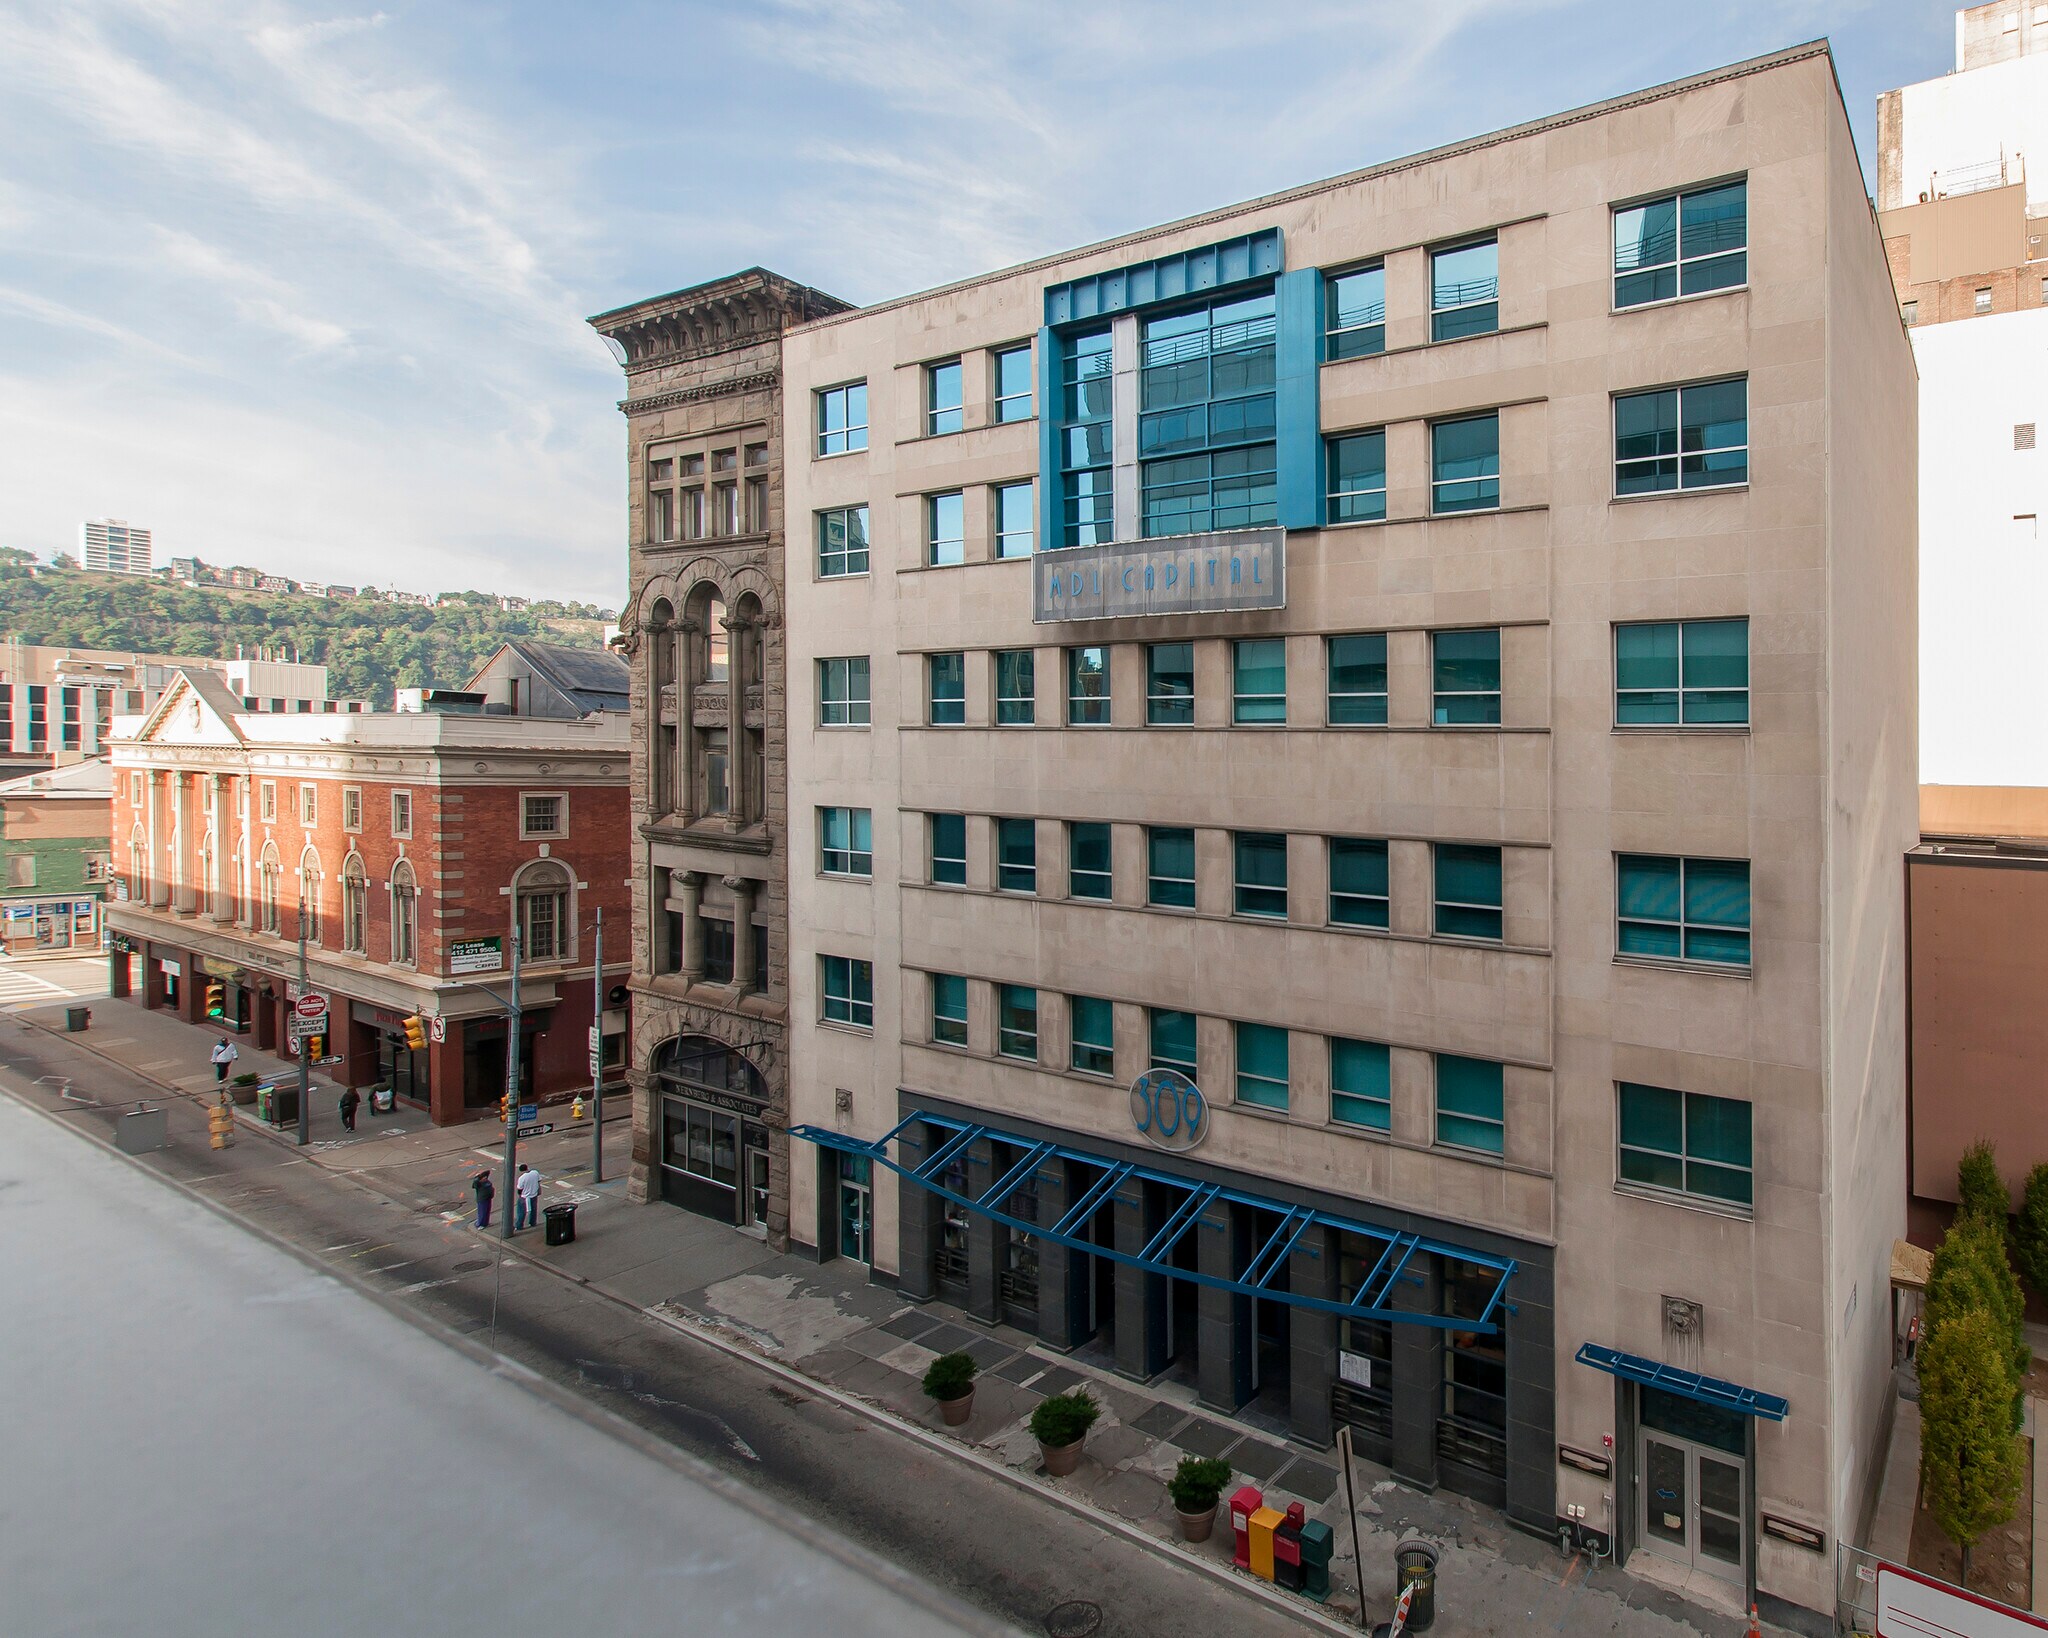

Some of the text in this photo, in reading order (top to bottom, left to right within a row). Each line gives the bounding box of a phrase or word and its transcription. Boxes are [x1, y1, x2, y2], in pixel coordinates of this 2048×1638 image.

[1049, 556, 1262, 599] MDL CAPITAL
[675, 1084, 757, 1114] NERNBERG & ASSOCIATES
[1136, 1076, 1203, 1141] 309
[1783, 1495, 1805, 1509] 309
